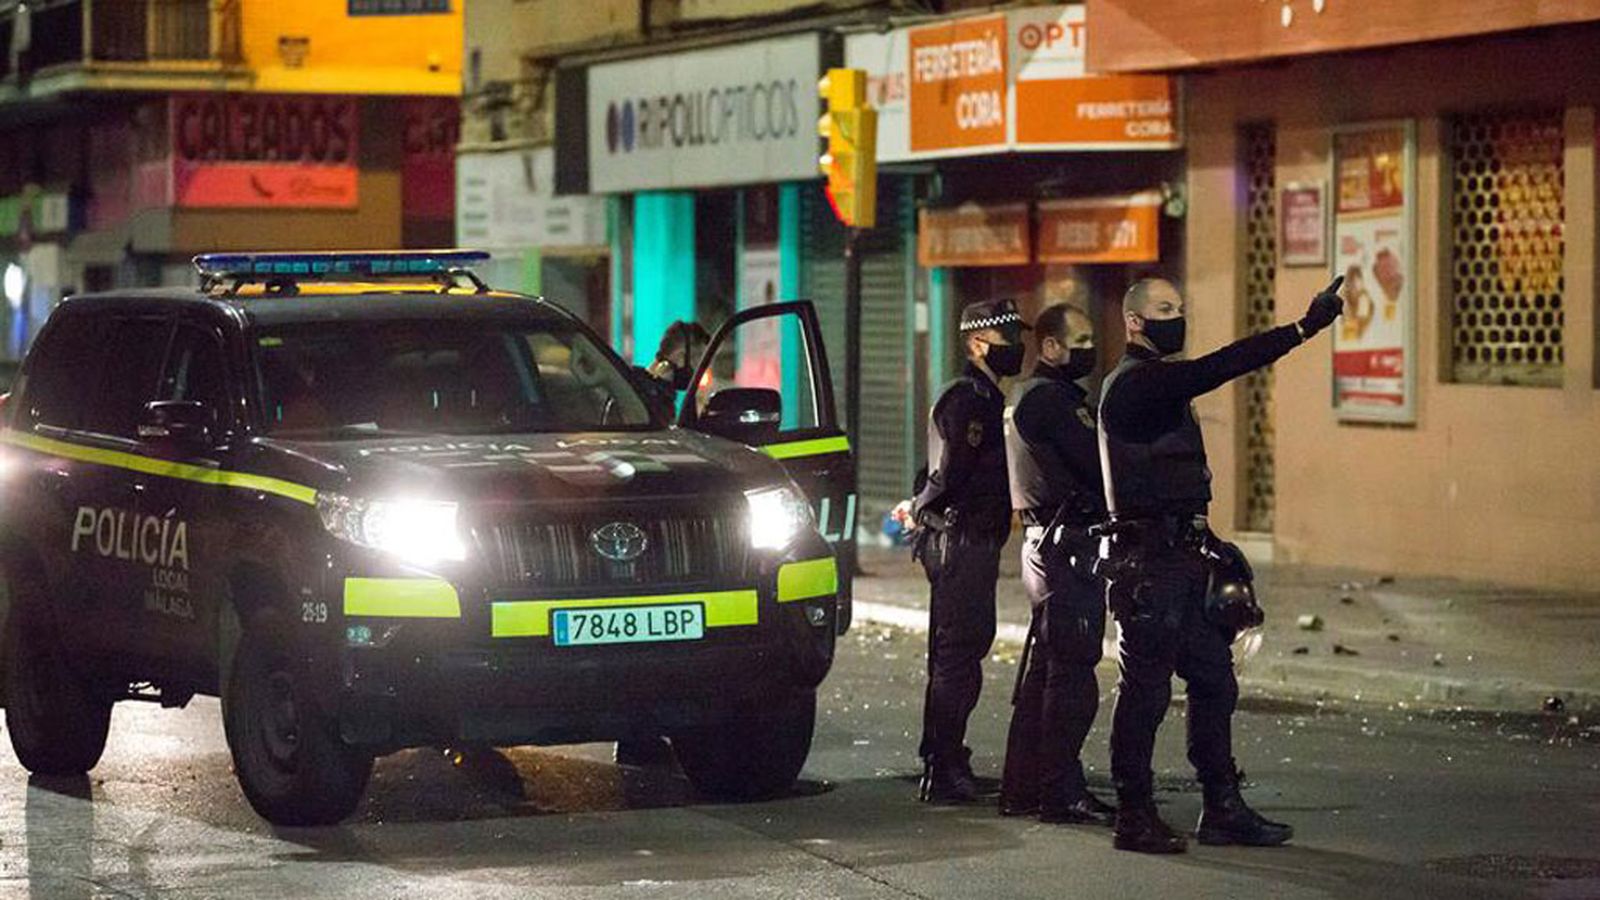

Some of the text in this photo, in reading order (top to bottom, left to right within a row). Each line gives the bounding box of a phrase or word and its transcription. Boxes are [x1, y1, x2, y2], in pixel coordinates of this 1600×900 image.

[177, 97, 352, 162] CALZADOS
[956, 90, 1003, 131] CORA
[71, 506, 189, 571] POLICÍA
[153, 568, 189, 593] LOCAL
[572, 609, 695, 640] 7848 LBP
